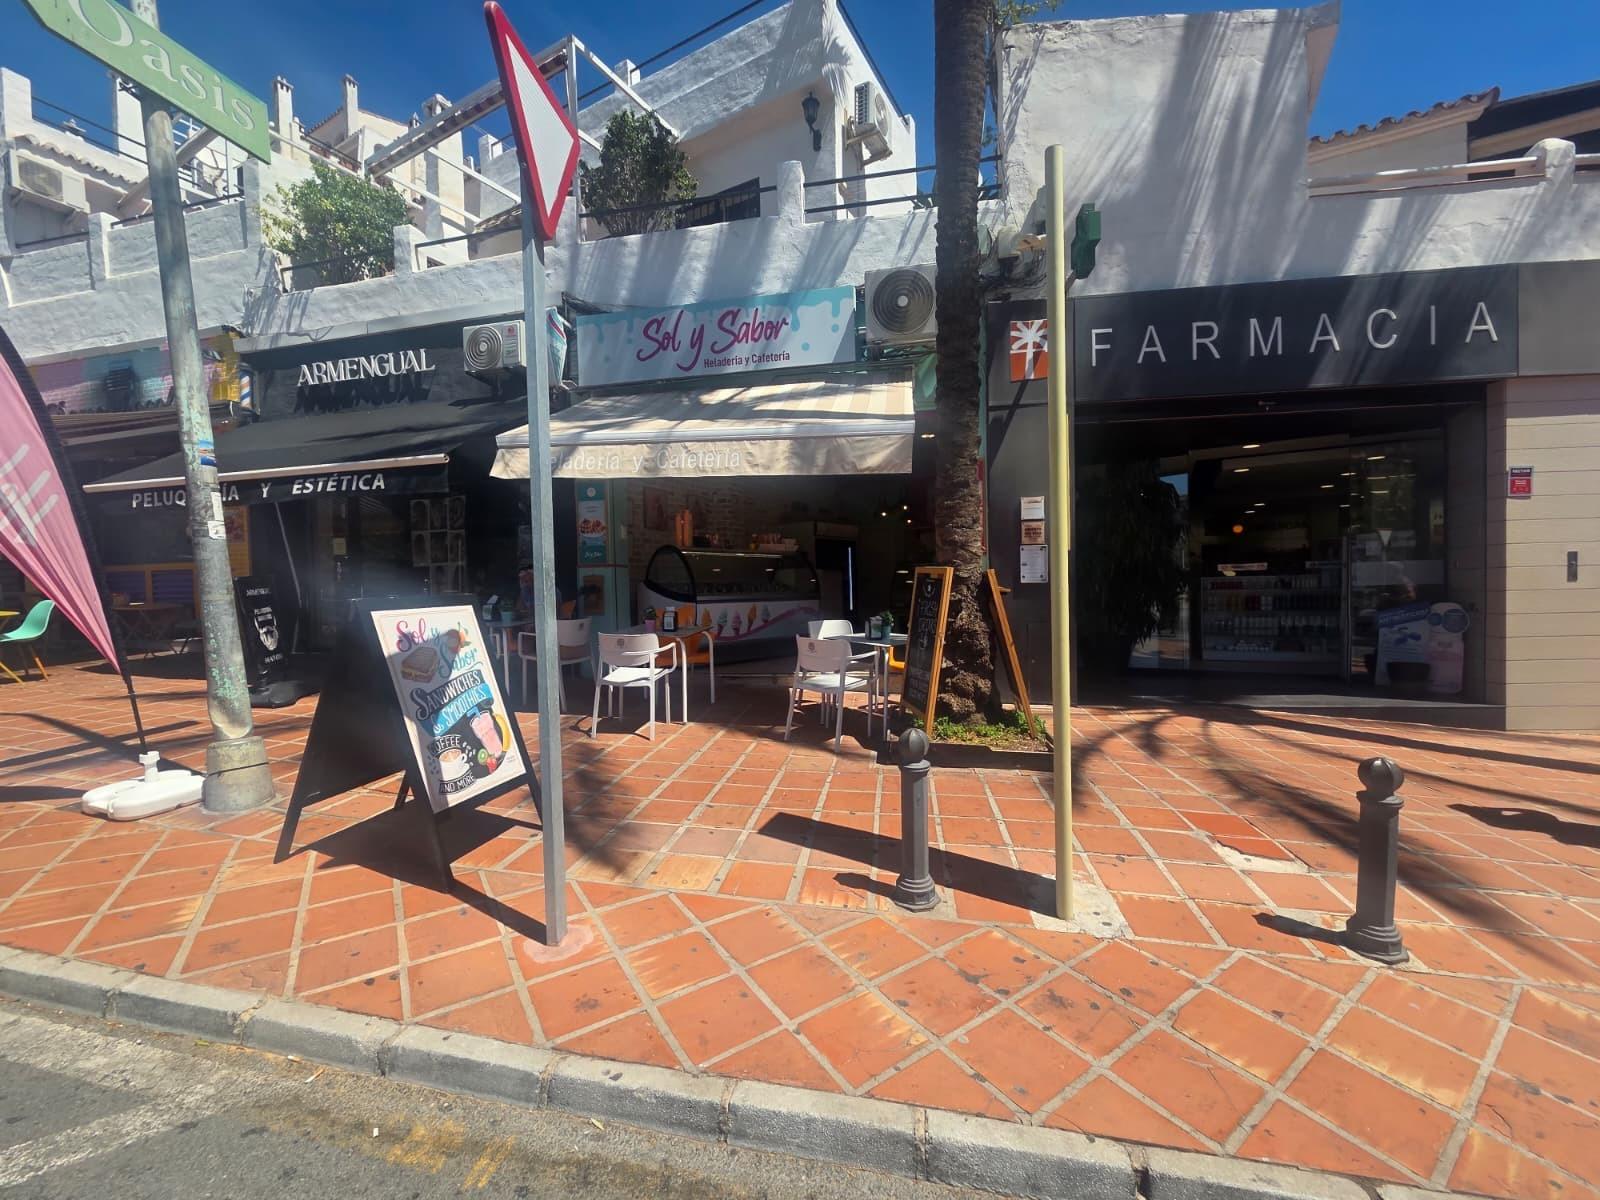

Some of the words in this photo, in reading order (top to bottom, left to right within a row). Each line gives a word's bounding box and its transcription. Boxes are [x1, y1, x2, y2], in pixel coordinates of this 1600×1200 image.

[67, 0, 256, 131] Oasis
[636, 309, 685, 362] Sol
[676, 322, 705, 372] y
[710, 307, 789, 355] Sabor
[1090, 301, 1499, 367] FARMACIA
[297, 348, 436, 387] ARMENGUAL
[703, 354, 743, 369] Heladería
[744, 356, 750, 367] y
[751, 350, 790, 364] Cafetería
[632, 453, 644, 473] y
[132, 484, 240, 508] PELUQÍA
[260, 482, 272, 499] Y
[291, 472, 386, 495] ESTÉTICA
[395, 617, 429, 653] Sol
[430, 626, 441, 646] y
[437, 642, 478, 679] Sabor
[411, 670, 481, 720] SANDWICHES
[441, 685, 487, 727] SMOOTHIES
[440, 781, 456, 793] AND
[456, 772, 475, 789] MORE
